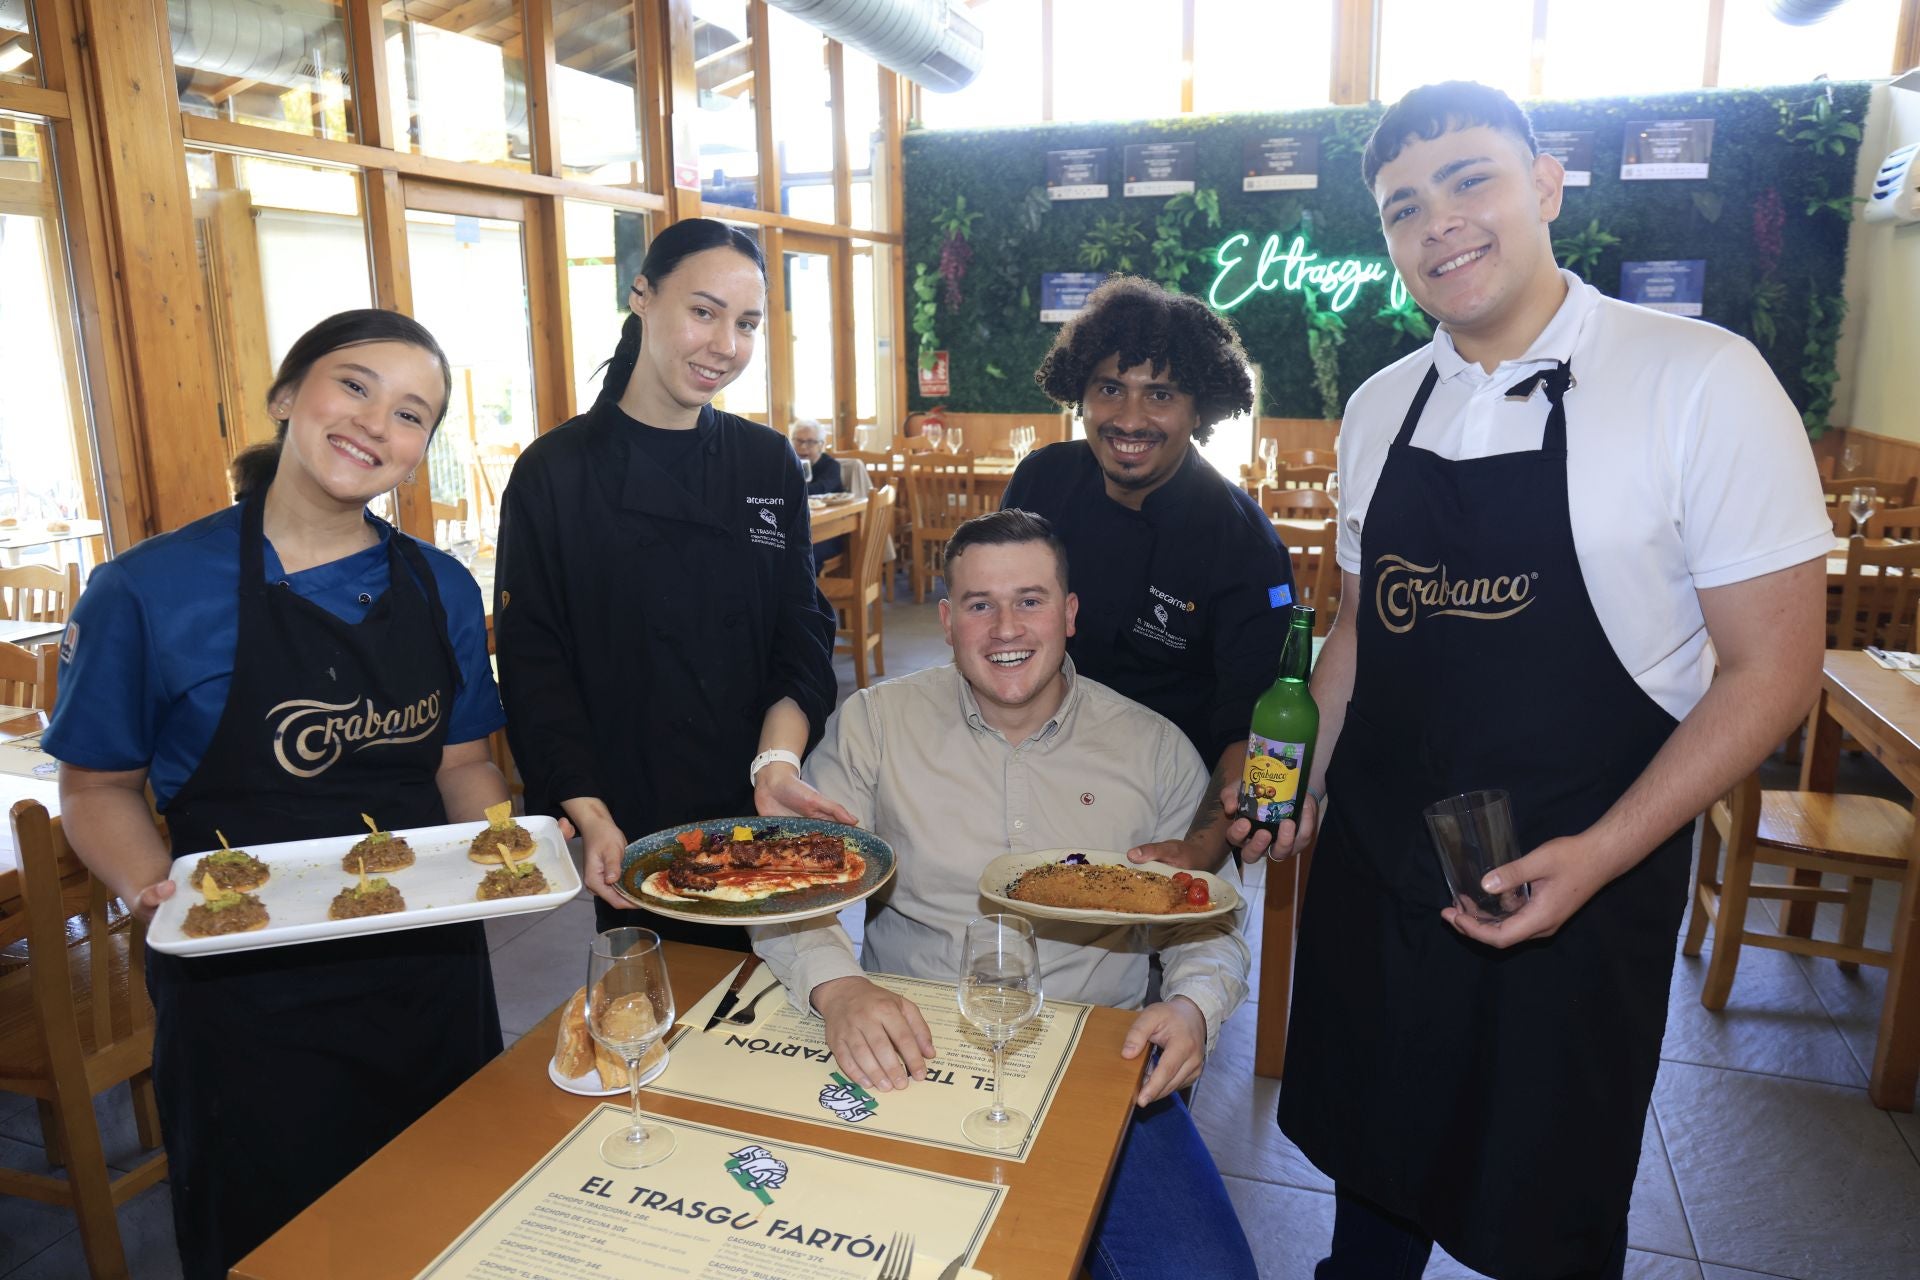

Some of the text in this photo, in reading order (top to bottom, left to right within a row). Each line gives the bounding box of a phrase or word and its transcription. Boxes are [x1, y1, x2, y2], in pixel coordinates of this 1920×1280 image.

[1209, 234, 1278, 310] El
[1150, 585, 1186, 610] arcecarne
[1374, 554, 1537, 633] Trabanco
[264, 692, 441, 778] Trabanco
[724, 1034, 834, 1063] FARTÓN
[548, 1192, 584, 1205] CACHOPO
[584, 1200, 632, 1218] TRADICIONAL
[579, 1176, 614, 1198] EL
[628, 1186, 759, 1230] TRASGU
[520, 1219, 558, 1233] CACHOPO
[534, 1205, 570, 1219] CACHOPO
[570, 1214, 582, 1222] DE
[582, 1216, 612, 1229] CECINA
[500, 1239, 538, 1252] CACHOPO
[727, 1235, 766, 1250] CACHOPO
[479, 1259, 517, 1274] CACHOPO
[708, 1260, 748, 1275] CACHOPO
